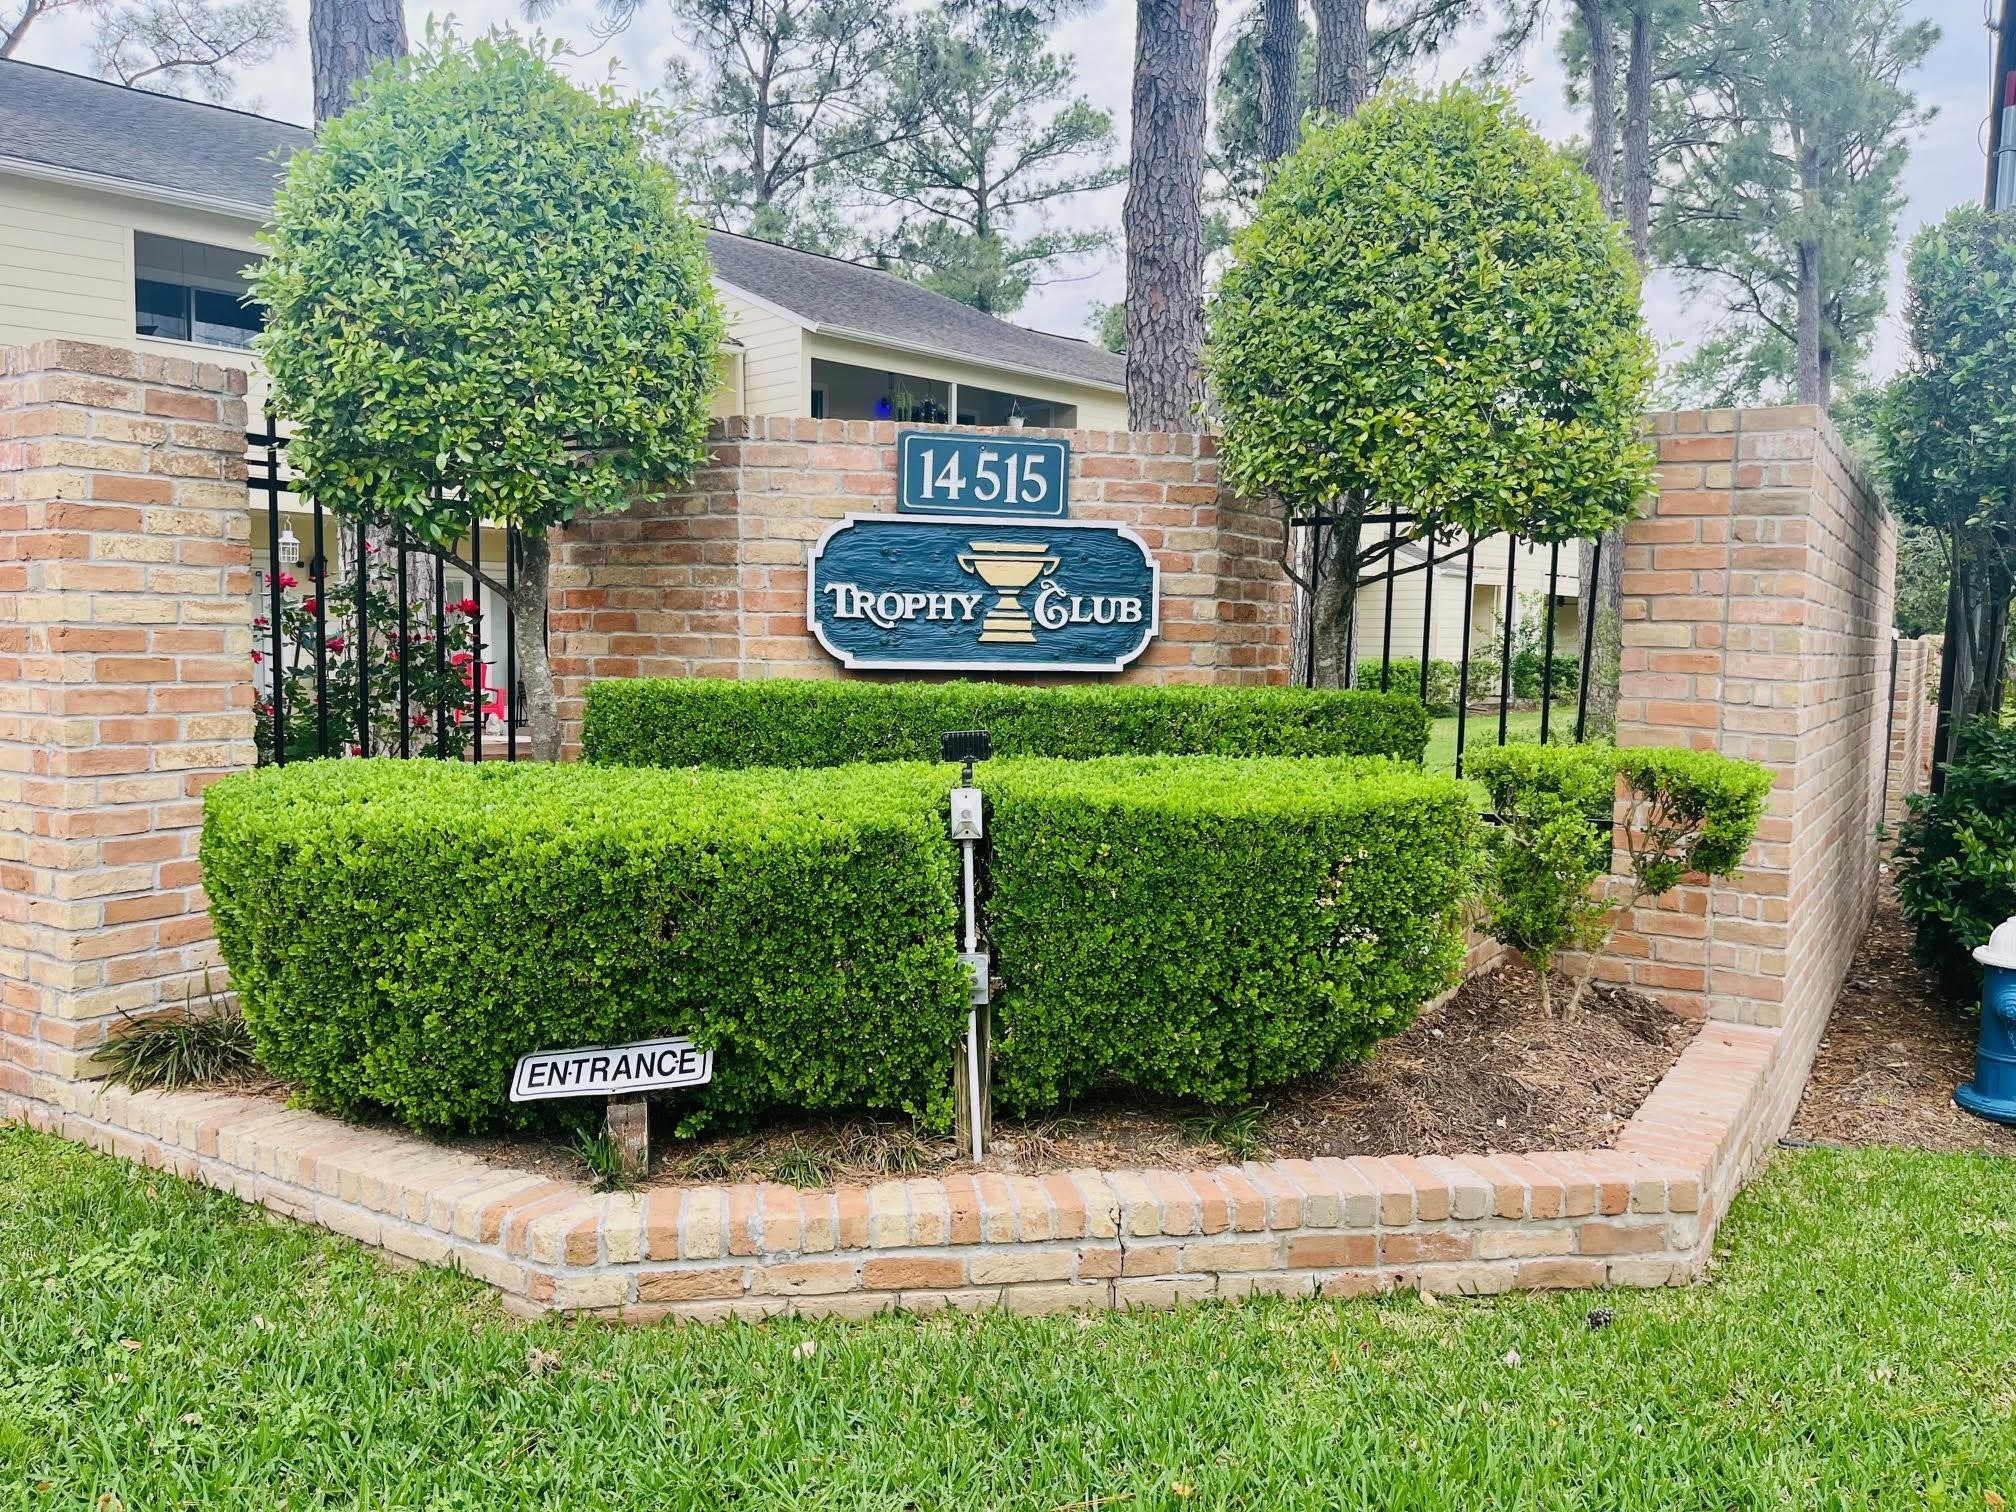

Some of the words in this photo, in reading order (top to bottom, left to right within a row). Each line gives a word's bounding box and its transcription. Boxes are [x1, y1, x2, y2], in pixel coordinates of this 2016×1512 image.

[823, 583, 983, 629] TROPHY
[1034, 580, 1142, 630] CLUB
[527, 1048, 697, 1088] ENTRANCE
